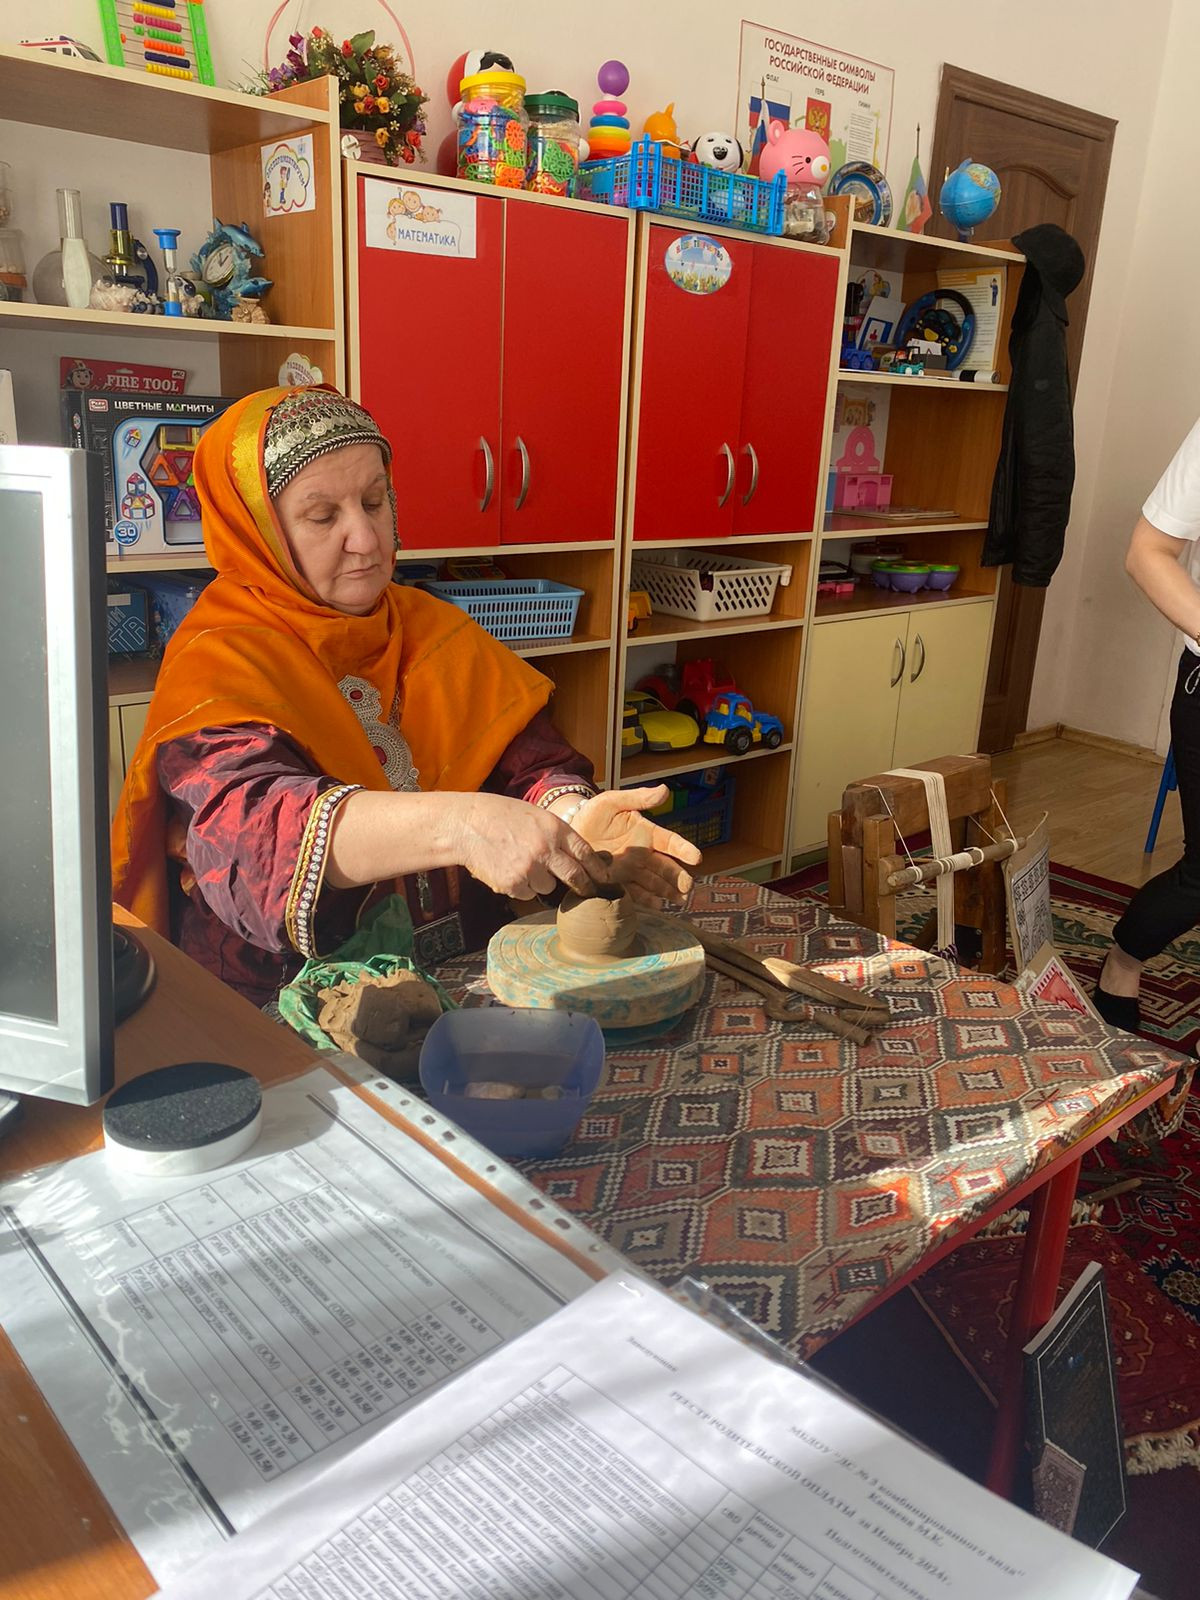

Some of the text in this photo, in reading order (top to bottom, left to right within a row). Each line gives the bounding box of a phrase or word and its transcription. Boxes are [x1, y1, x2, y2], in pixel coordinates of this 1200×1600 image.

[764, 37, 877, 82] ГОСУДАРСТВЕННЫЕ СИМВОЛЫ
[765, 73, 780, 83] ФЛАГ
[769, 55, 870, 94] РОССИЙСКОЙ ФЕДЕРАЦИИ
[398, 228, 457, 247] МАТЕМАТИКА
[106, 374, 140, 388] FIRE
[142, 378, 180, 392] TOOL
[114, 401, 162, 412] ЦВЕТНЫЕ
[118, 527, 136, 537] 30
